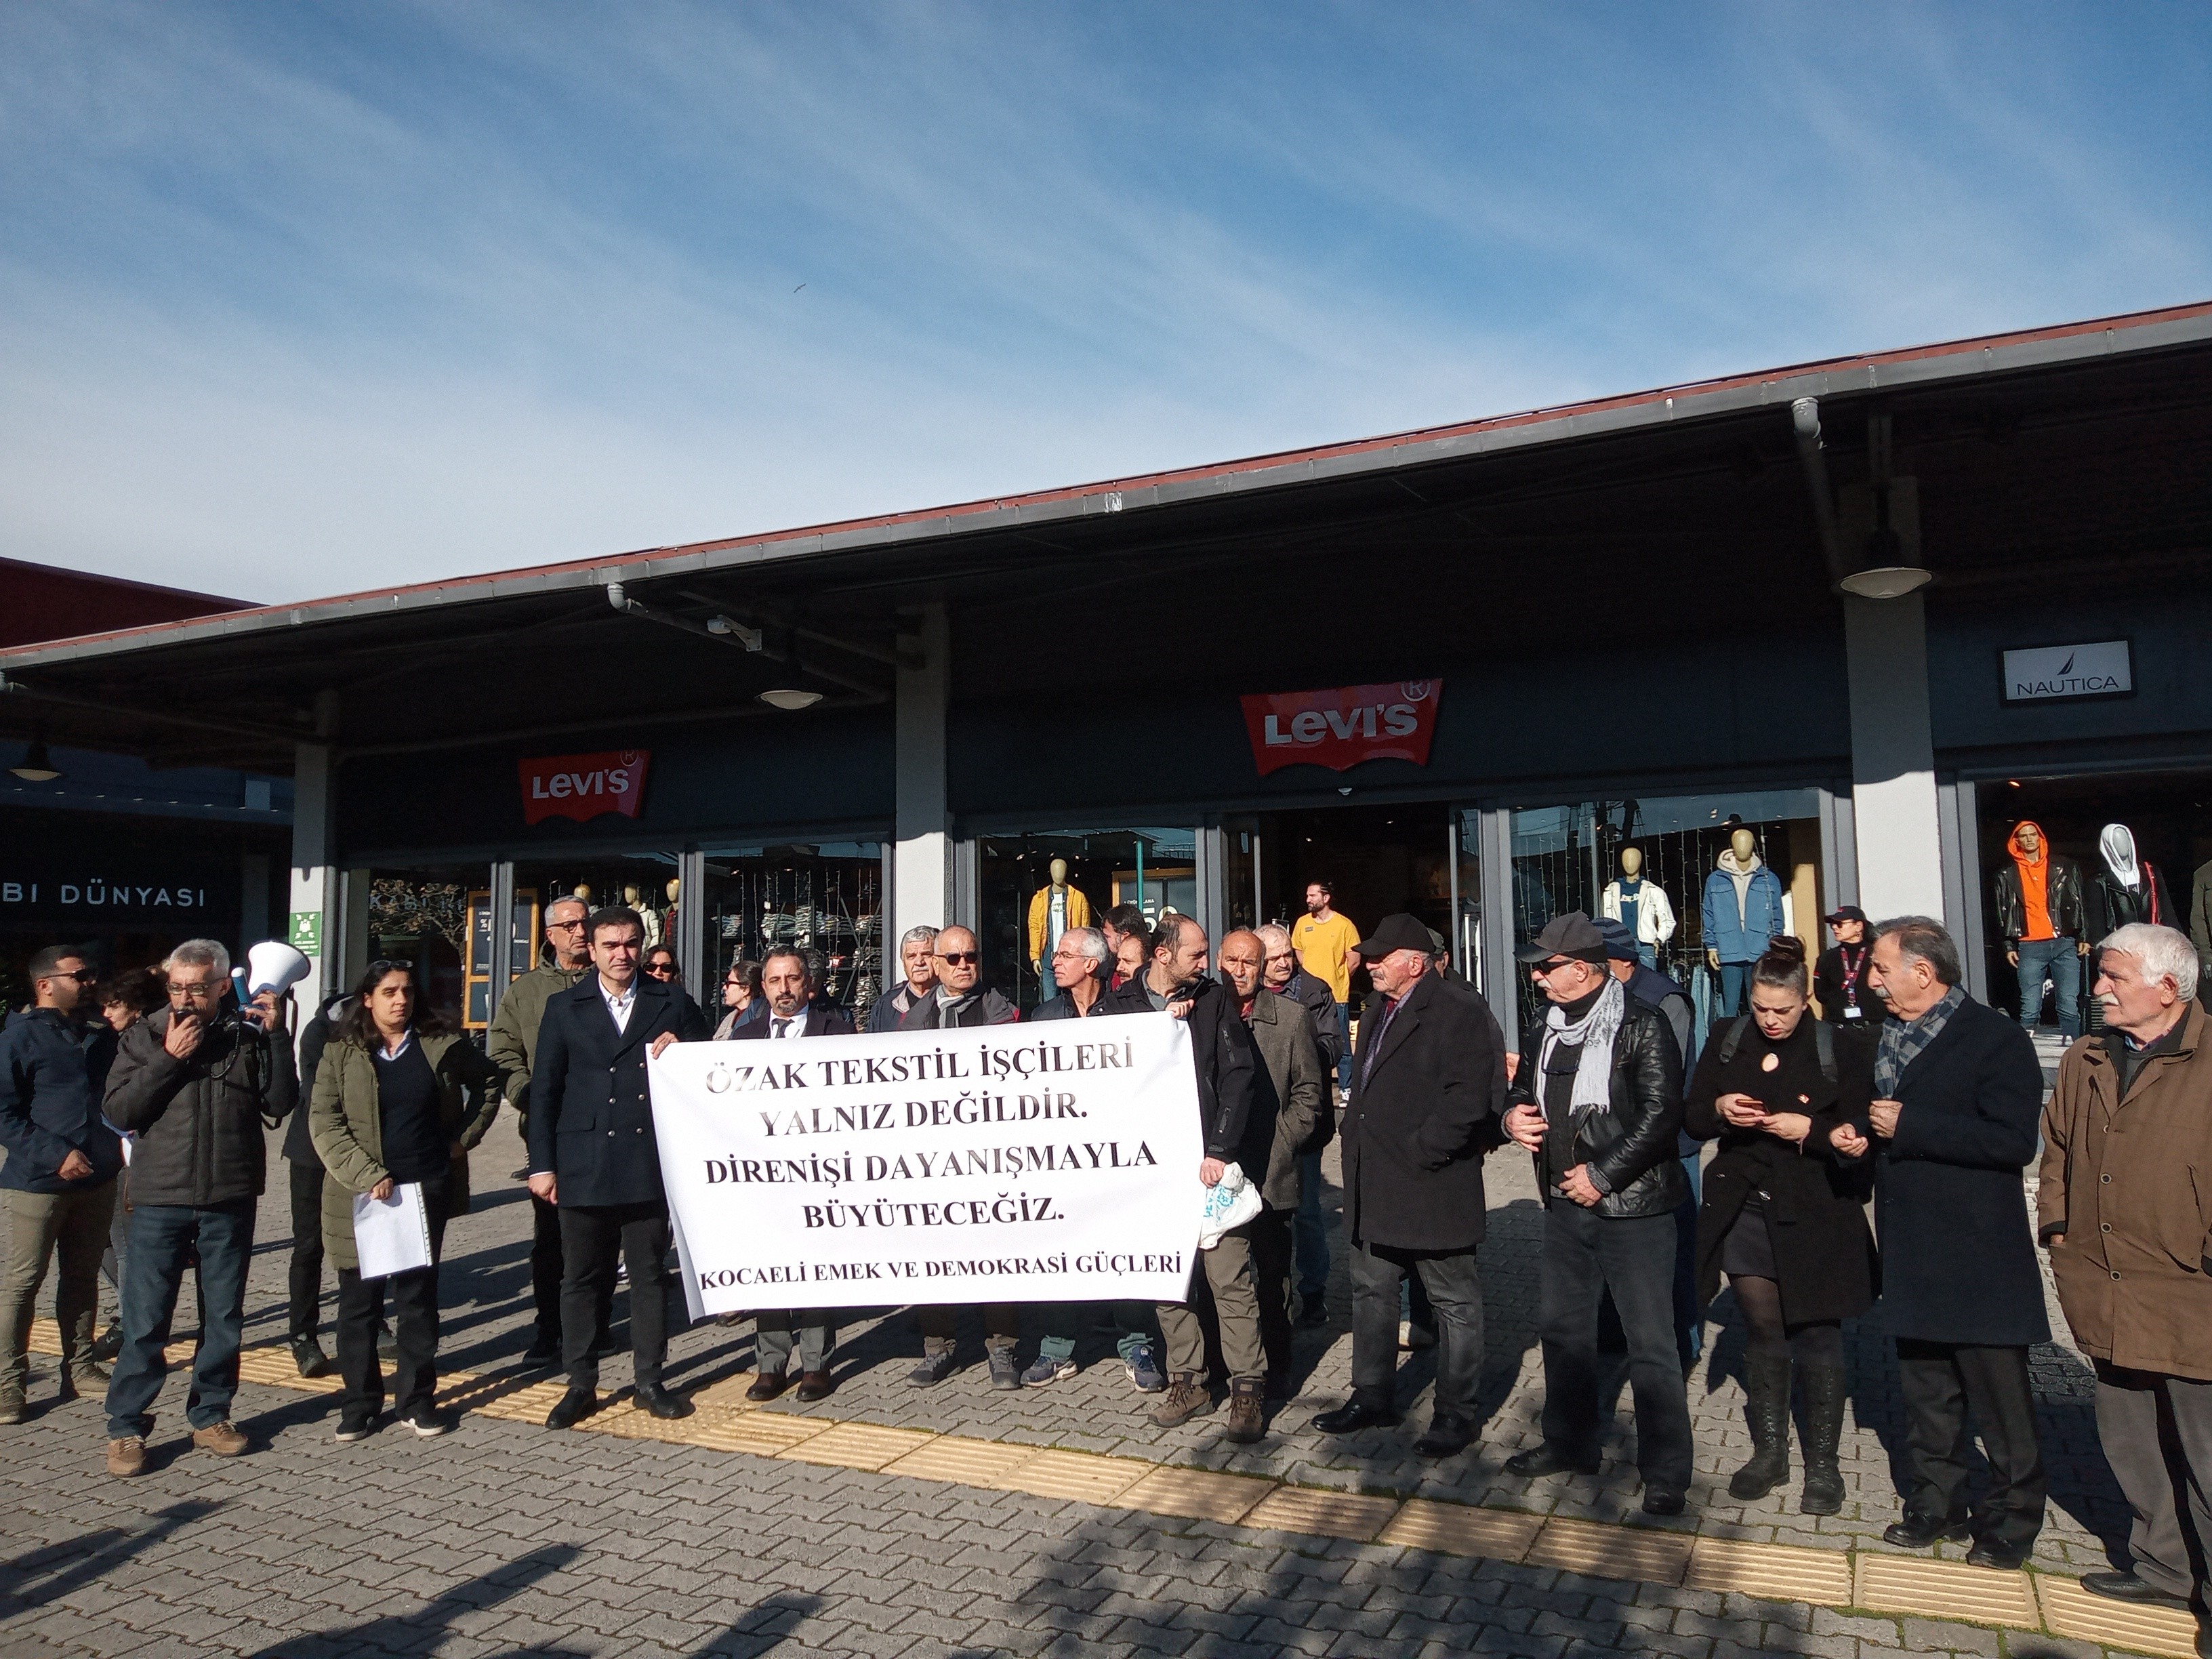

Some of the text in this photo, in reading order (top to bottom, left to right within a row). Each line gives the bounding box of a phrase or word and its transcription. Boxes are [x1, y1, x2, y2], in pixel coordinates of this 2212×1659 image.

[2017, 676, 2120, 696] NAUTICA
[60, 878, 205, 907] DÜNYASI
[706, 1036, 1134, 1094] ÖZAK TEKSTİL İŞÇİLERİ
[759, 1087, 1088, 1137] YALNIZ DEĞİLDİR.
[703, 1141, 1159, 1189] DİRENİŞİ DAYANIŞMAYLA
[803, 1191, 1065, 1227] BÜYÜTECEĞİZ.
[700, 1250, 1181, 1290] KOCAELİ EMEK VE DEMOKRASİ GÜÇLERİ
